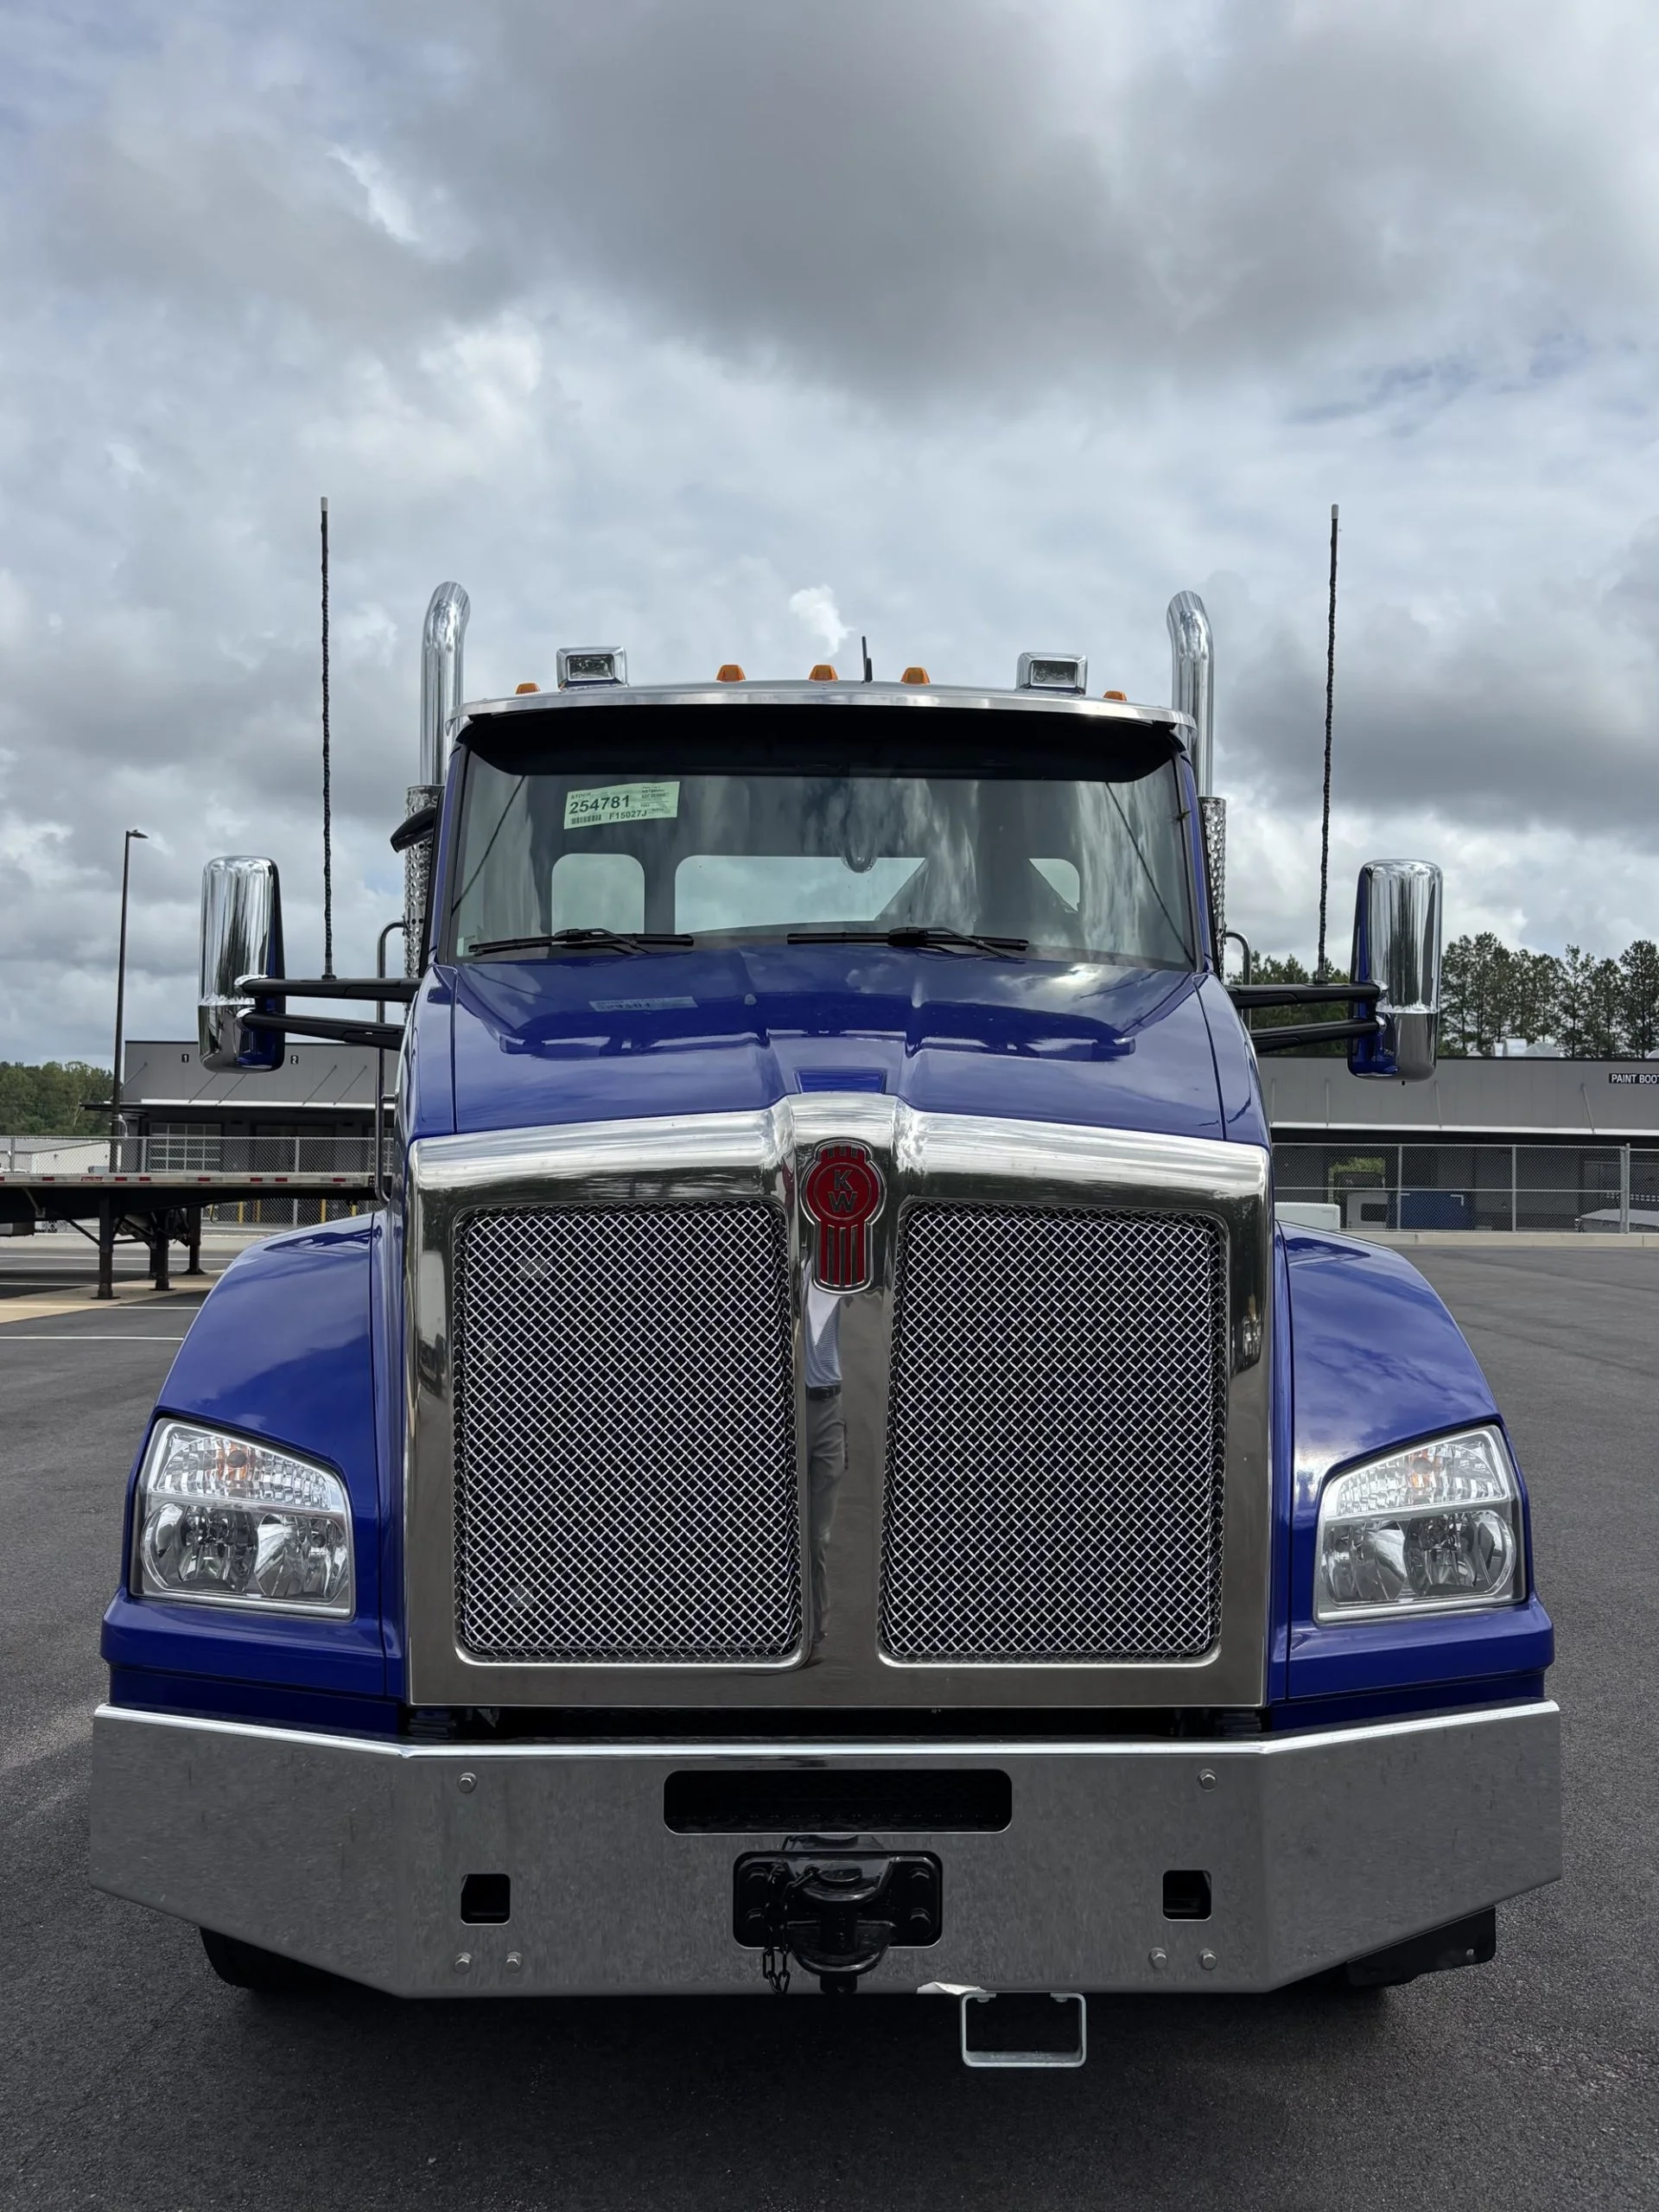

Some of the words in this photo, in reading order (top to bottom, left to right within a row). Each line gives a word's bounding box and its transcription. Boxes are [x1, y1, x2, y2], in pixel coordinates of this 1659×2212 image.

[569, 795, 630, 815] 254781
[608, 810, 647, 820] F15027J
[1611, 1074, 1637, 1084] PAINT
